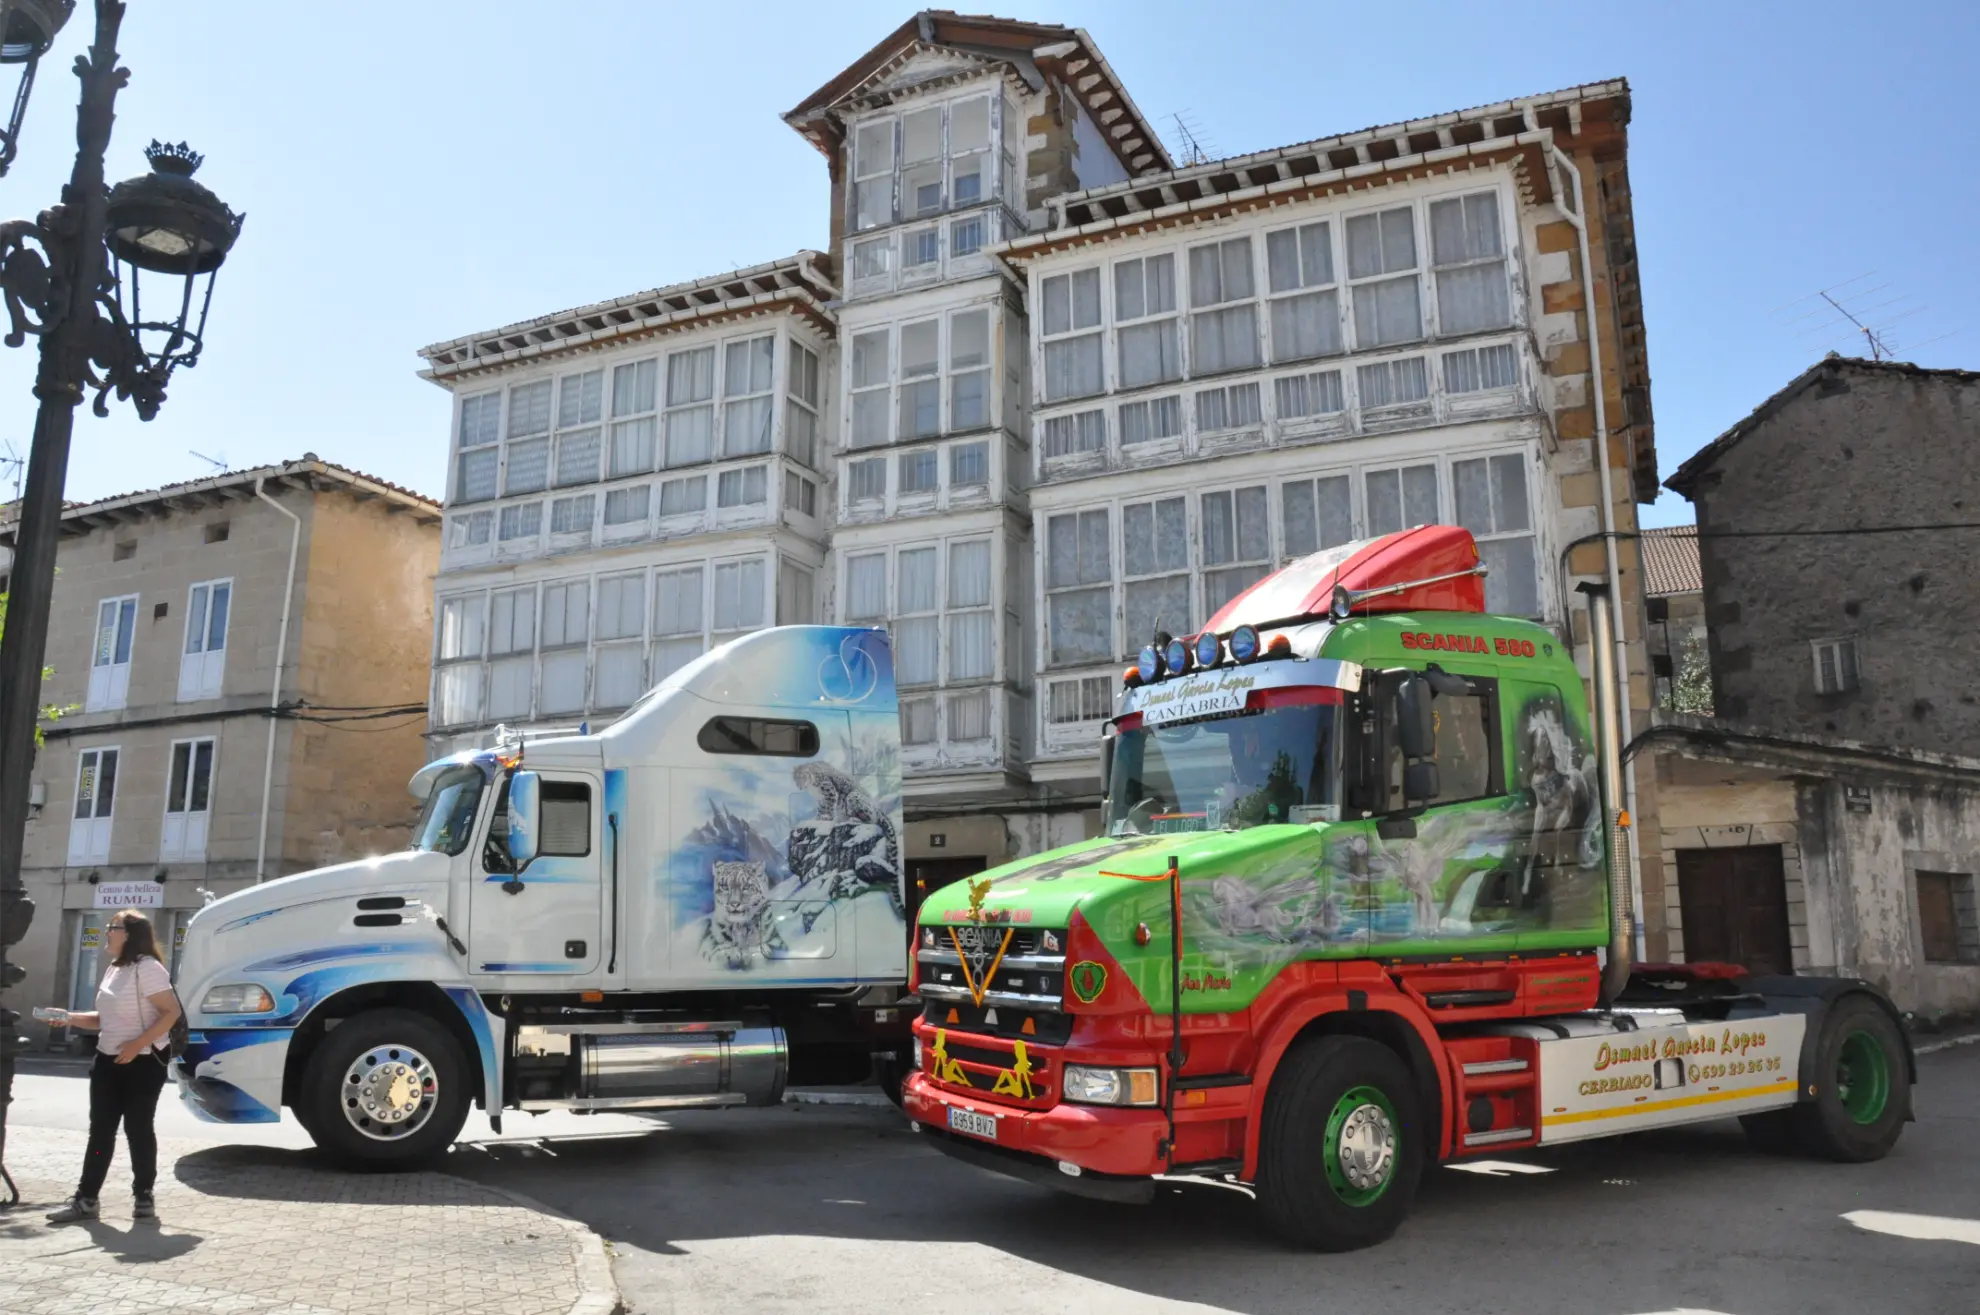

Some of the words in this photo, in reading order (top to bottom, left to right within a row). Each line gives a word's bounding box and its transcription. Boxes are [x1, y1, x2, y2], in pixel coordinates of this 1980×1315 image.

[1401, 632, 1489, 654] SCANIA
[1494, 638, 1535, 657] 580
[1146, 695, 1240, 721] CANTABRIA
[98, 885, 123, 894] Centro
[124, 885, 132, 893] de
[134, 883, 161, 894] belleza
[1721, 1028, 1766, 1056] Lopez
[953, 1111, 974, 1131] 8959
[976, 1116, 994, 1136] BVZ
